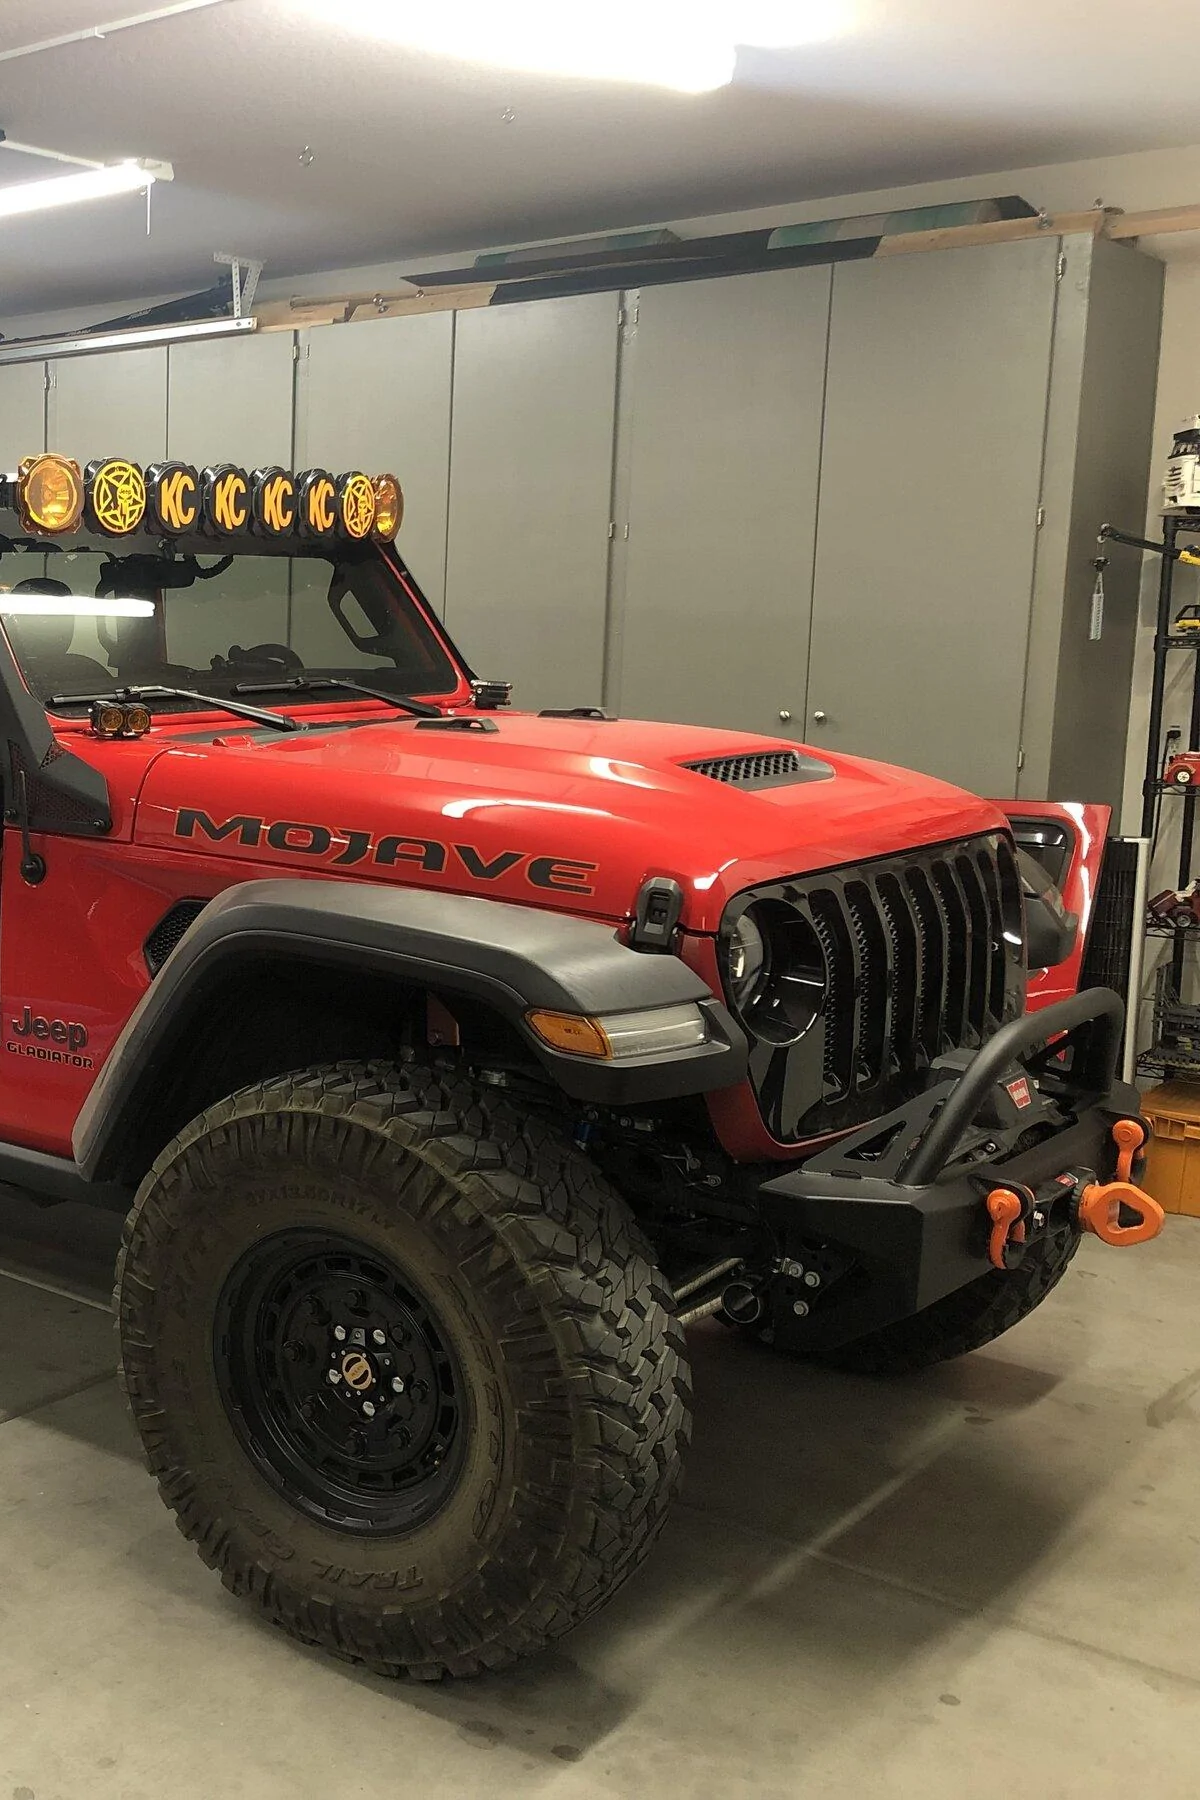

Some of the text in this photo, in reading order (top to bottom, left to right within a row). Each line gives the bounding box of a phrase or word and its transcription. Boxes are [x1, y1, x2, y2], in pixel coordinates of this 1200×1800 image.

[161, 470, 195, 529] KC
[215, 473, 246, 531] KC
[264, 476, 293, 531] KC
[309, 479, 335, 532] KC
[173, 806, 599, 896] MOJAVE
[6, 1041, 94, 1070] GLADIATOR
[11, 1005, 88, 1053] Jeep
